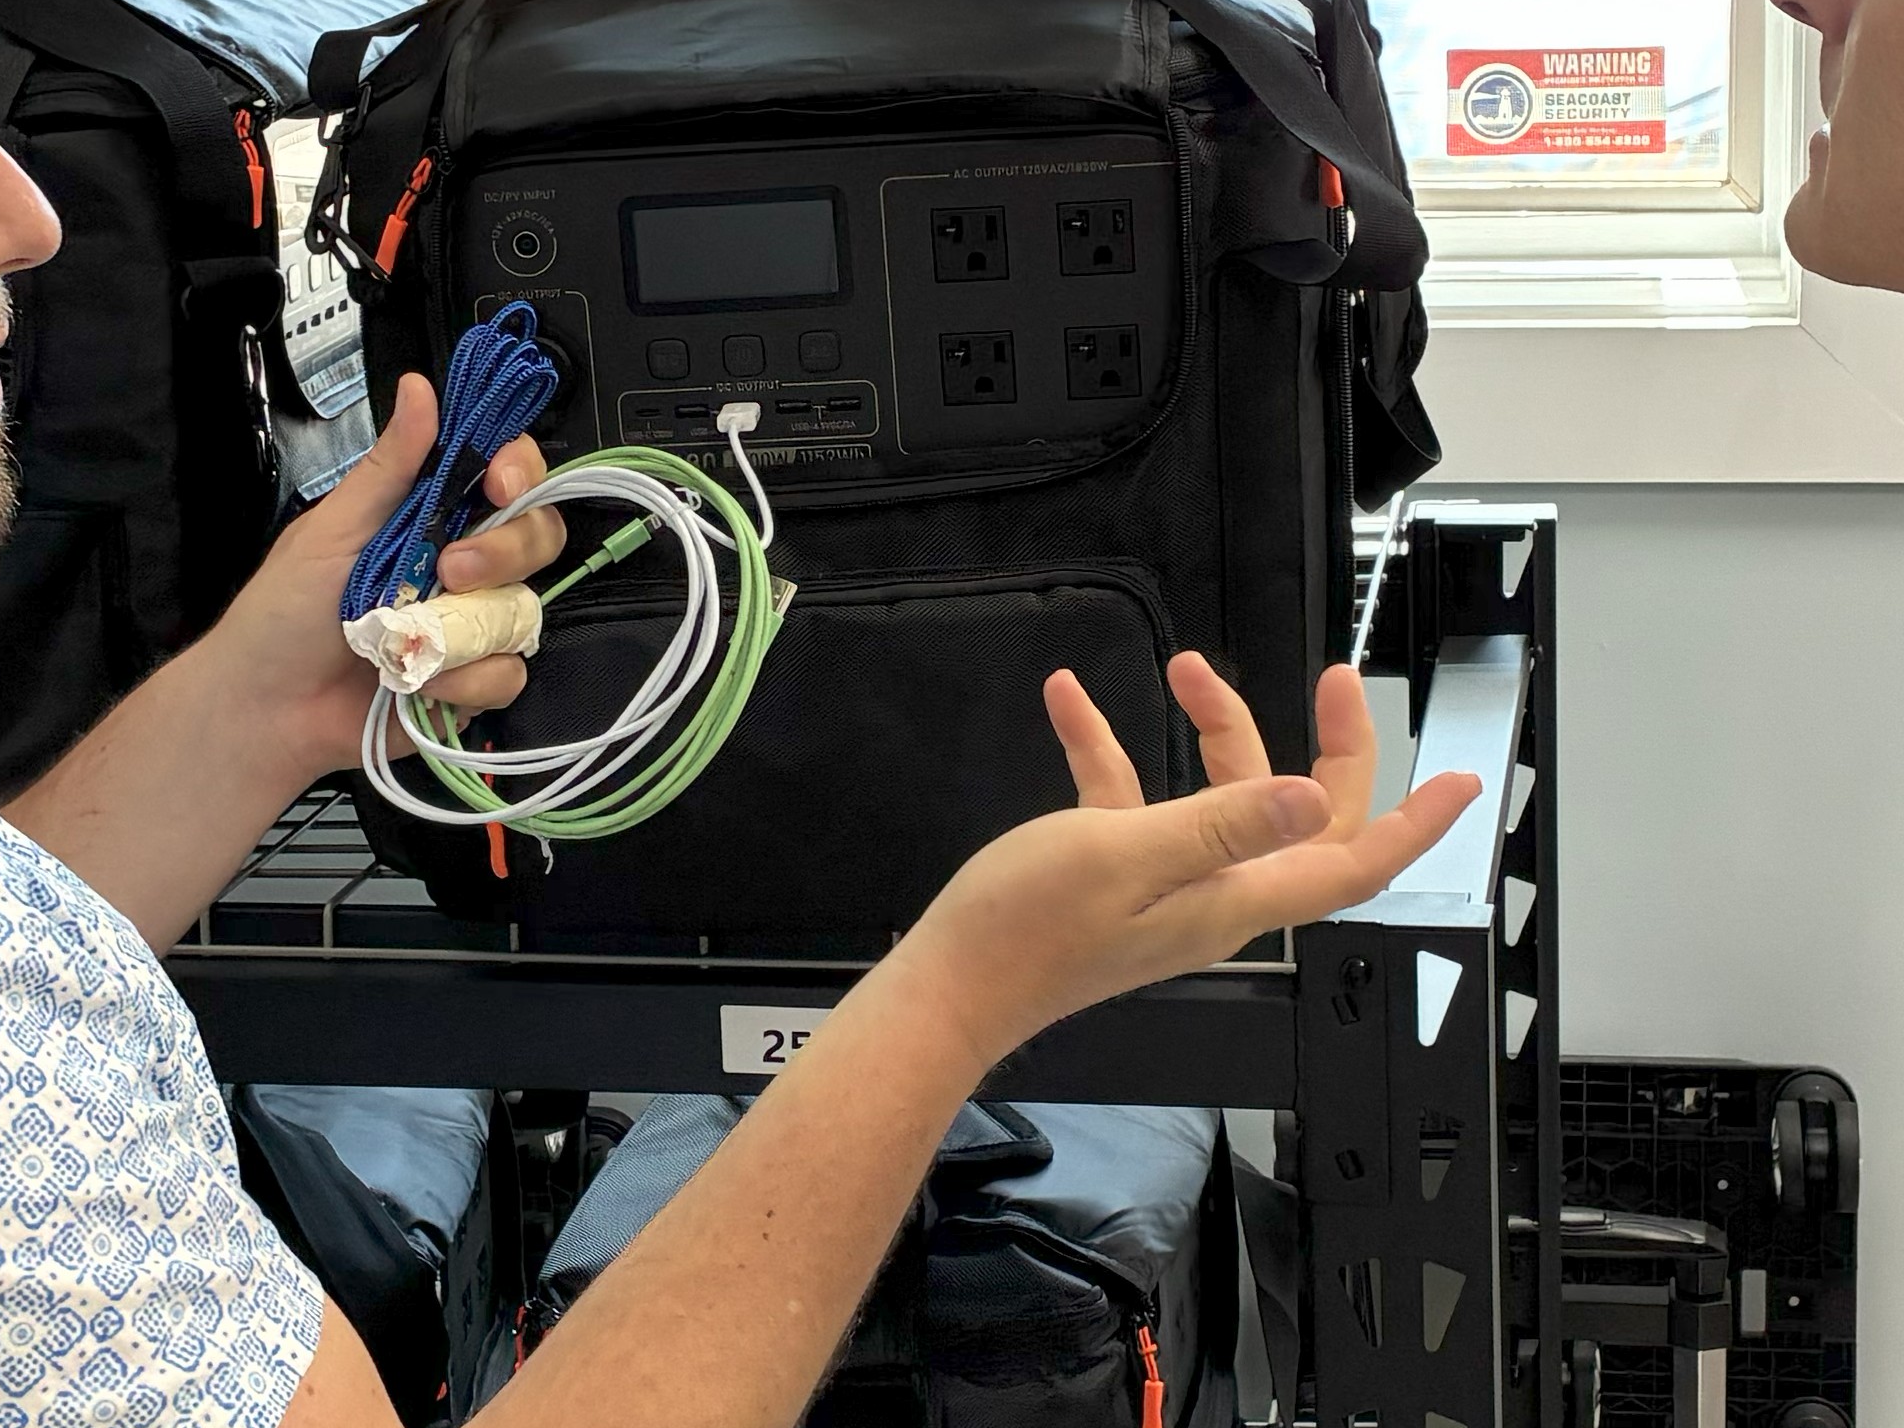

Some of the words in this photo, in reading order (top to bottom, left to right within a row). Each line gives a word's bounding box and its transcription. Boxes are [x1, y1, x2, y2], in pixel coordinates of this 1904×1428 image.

[1543, 51, 1651, 75] WARNING
[1545, 92, 1631, 106] SEACOAST
[1545, 108, 1631, 120] SECURITY
[953, 169, 969, 180] AC
[974, 166, 1019, 179] OUTPUT
[523, 189, 556, 201] INPUT
